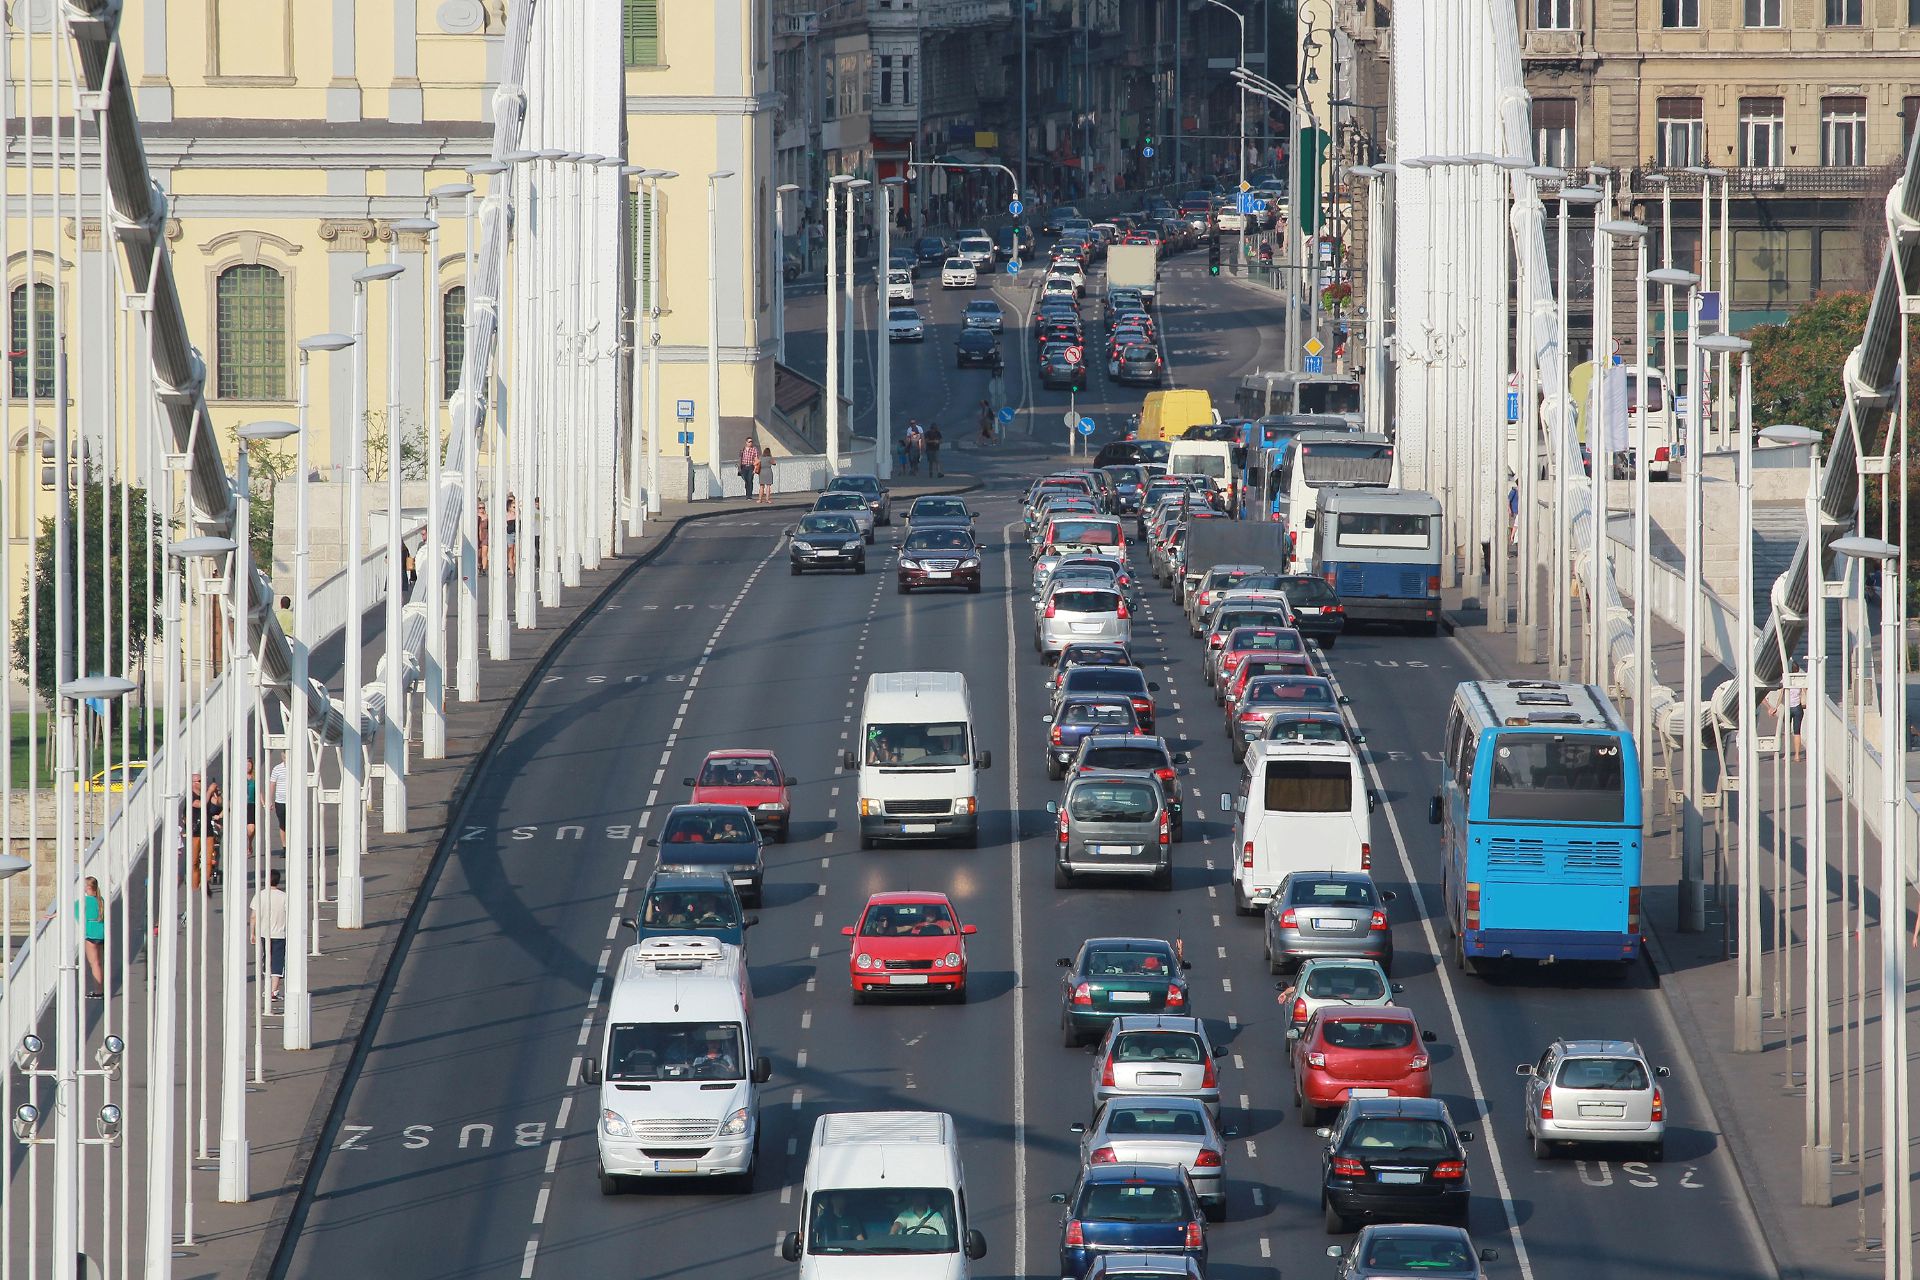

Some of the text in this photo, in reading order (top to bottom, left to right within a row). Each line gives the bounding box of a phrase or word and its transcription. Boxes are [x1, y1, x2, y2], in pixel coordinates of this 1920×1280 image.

[459, 825, 632, 841] BUSZ
[339, 1122, 547, 1150] BUSZ
[1534, 1160, 1704, 1188] USZ
